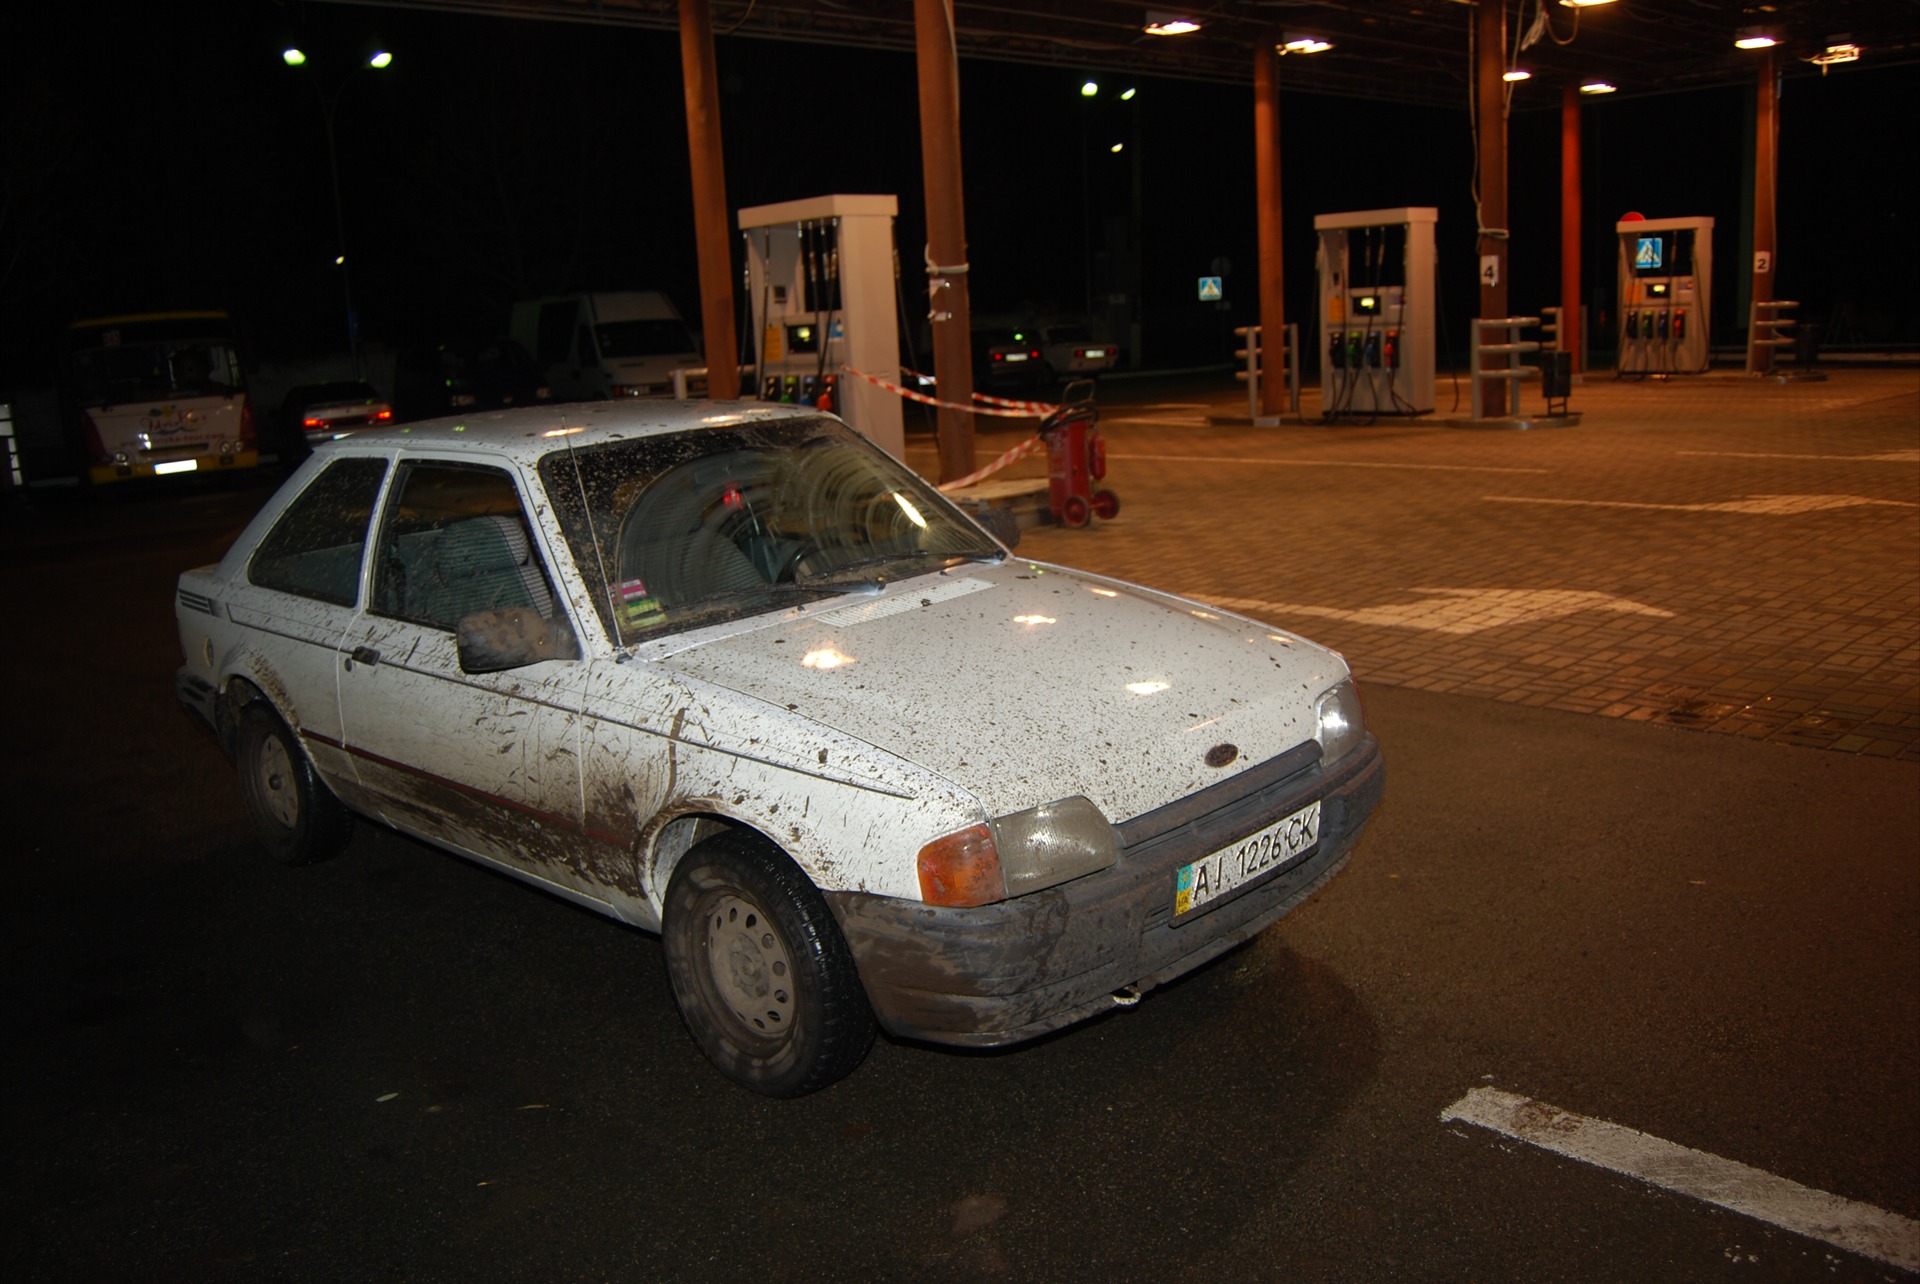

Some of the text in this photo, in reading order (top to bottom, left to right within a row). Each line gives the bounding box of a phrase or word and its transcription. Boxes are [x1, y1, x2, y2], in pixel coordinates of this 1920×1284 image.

[1757, 258, 1767, 270] 2
[1484, 265, 1494, 279] 4
[1236, 826, 1282, 878] 1226
[1288, 808, 1316, 850] CK
